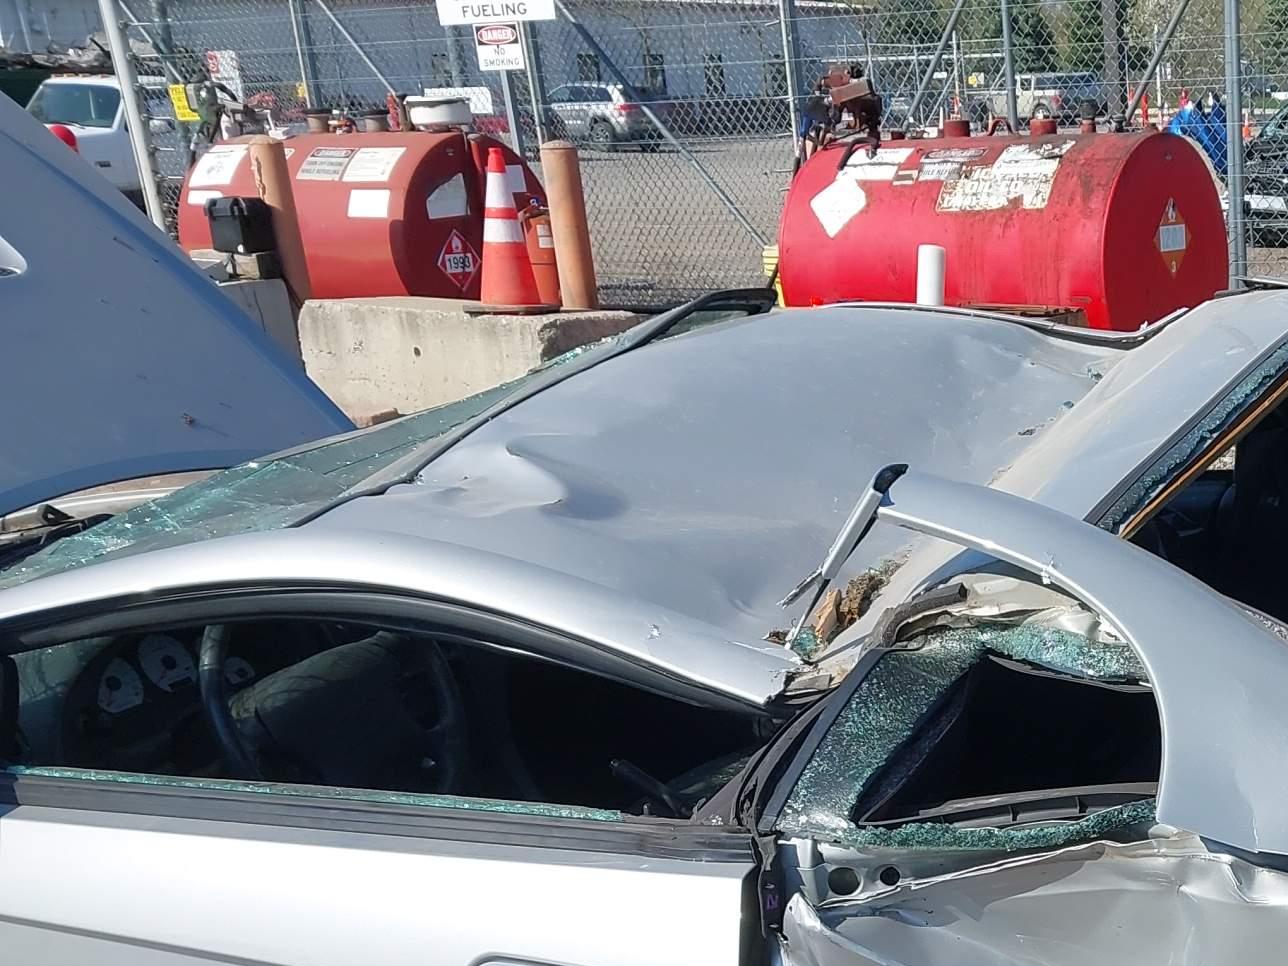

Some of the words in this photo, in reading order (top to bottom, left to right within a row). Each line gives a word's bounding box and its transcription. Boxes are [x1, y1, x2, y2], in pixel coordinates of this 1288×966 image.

[462, 2, 527, 18] FUELING
[481, 28, 513, 40] DANGER
[494, 48, 506, 56] NO
[483, 58, 520, 67] SMOKING
